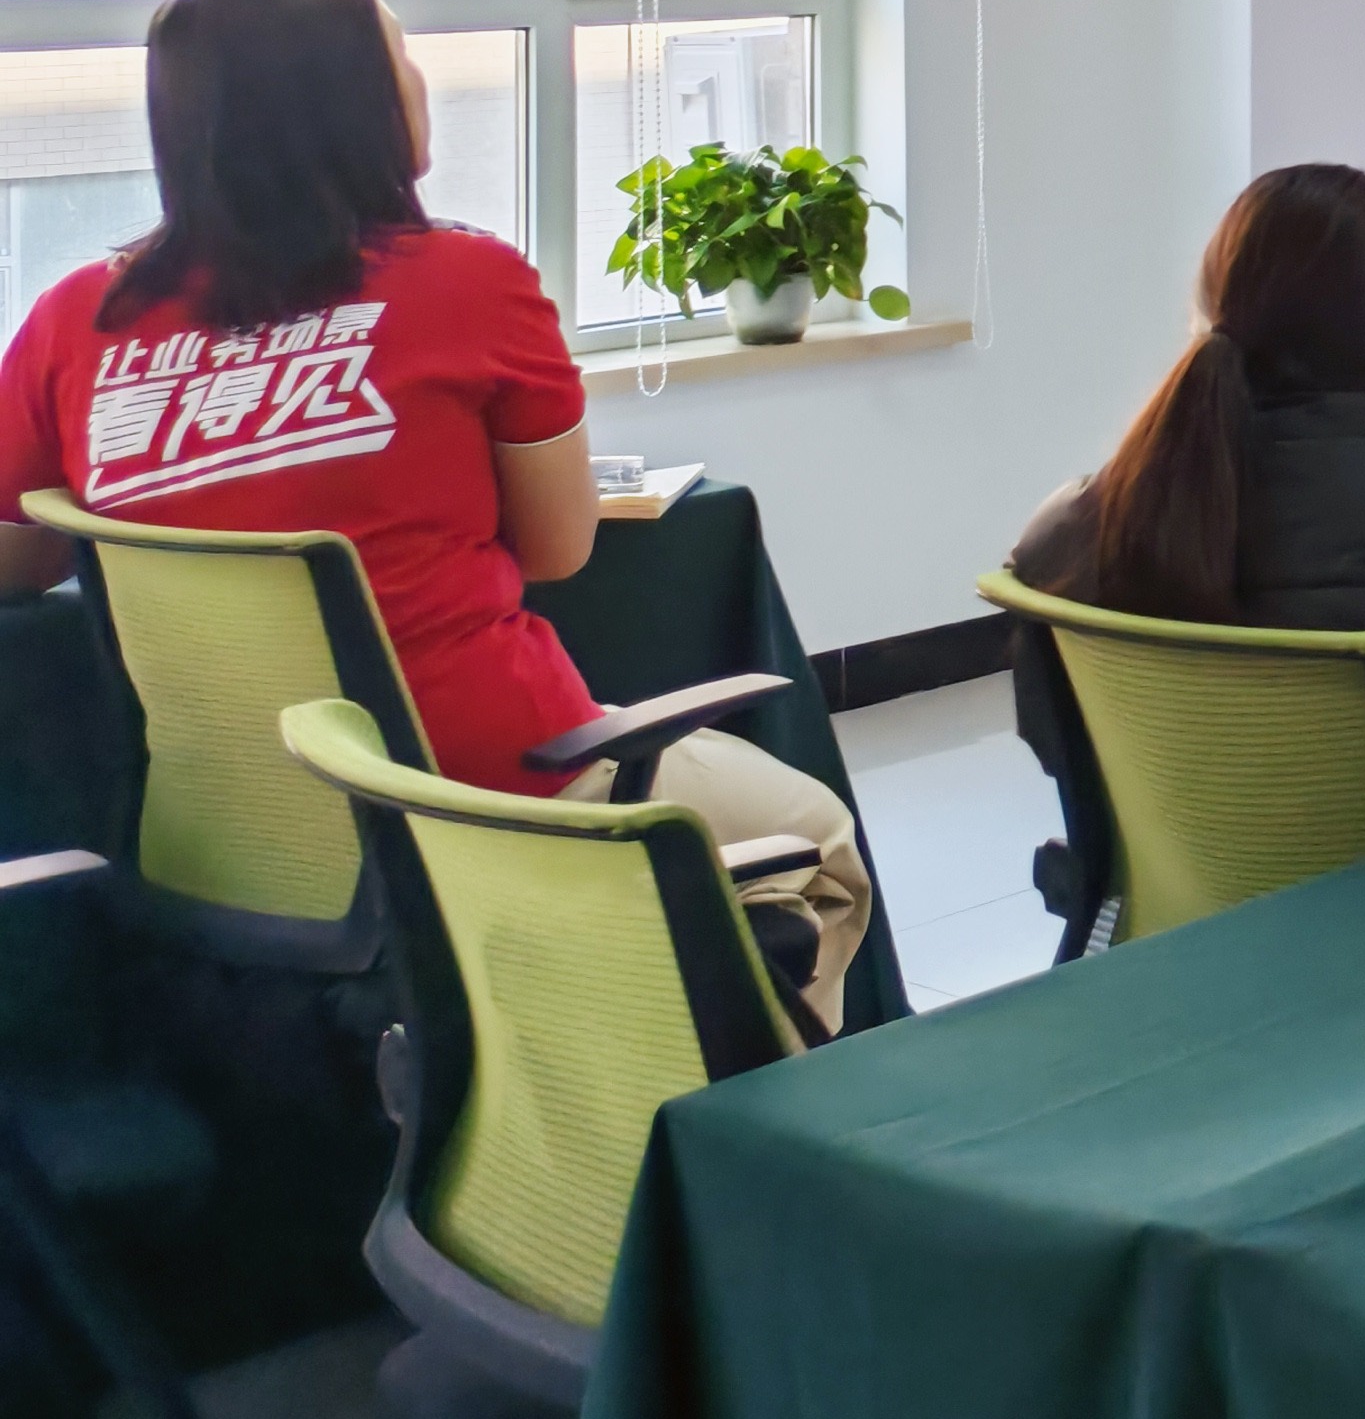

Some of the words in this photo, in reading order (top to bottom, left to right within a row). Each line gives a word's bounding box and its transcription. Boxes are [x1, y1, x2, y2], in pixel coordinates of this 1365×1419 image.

[94, 301, 388, 390] 让业务场景
[88, 345, 376, 466] 看得见
